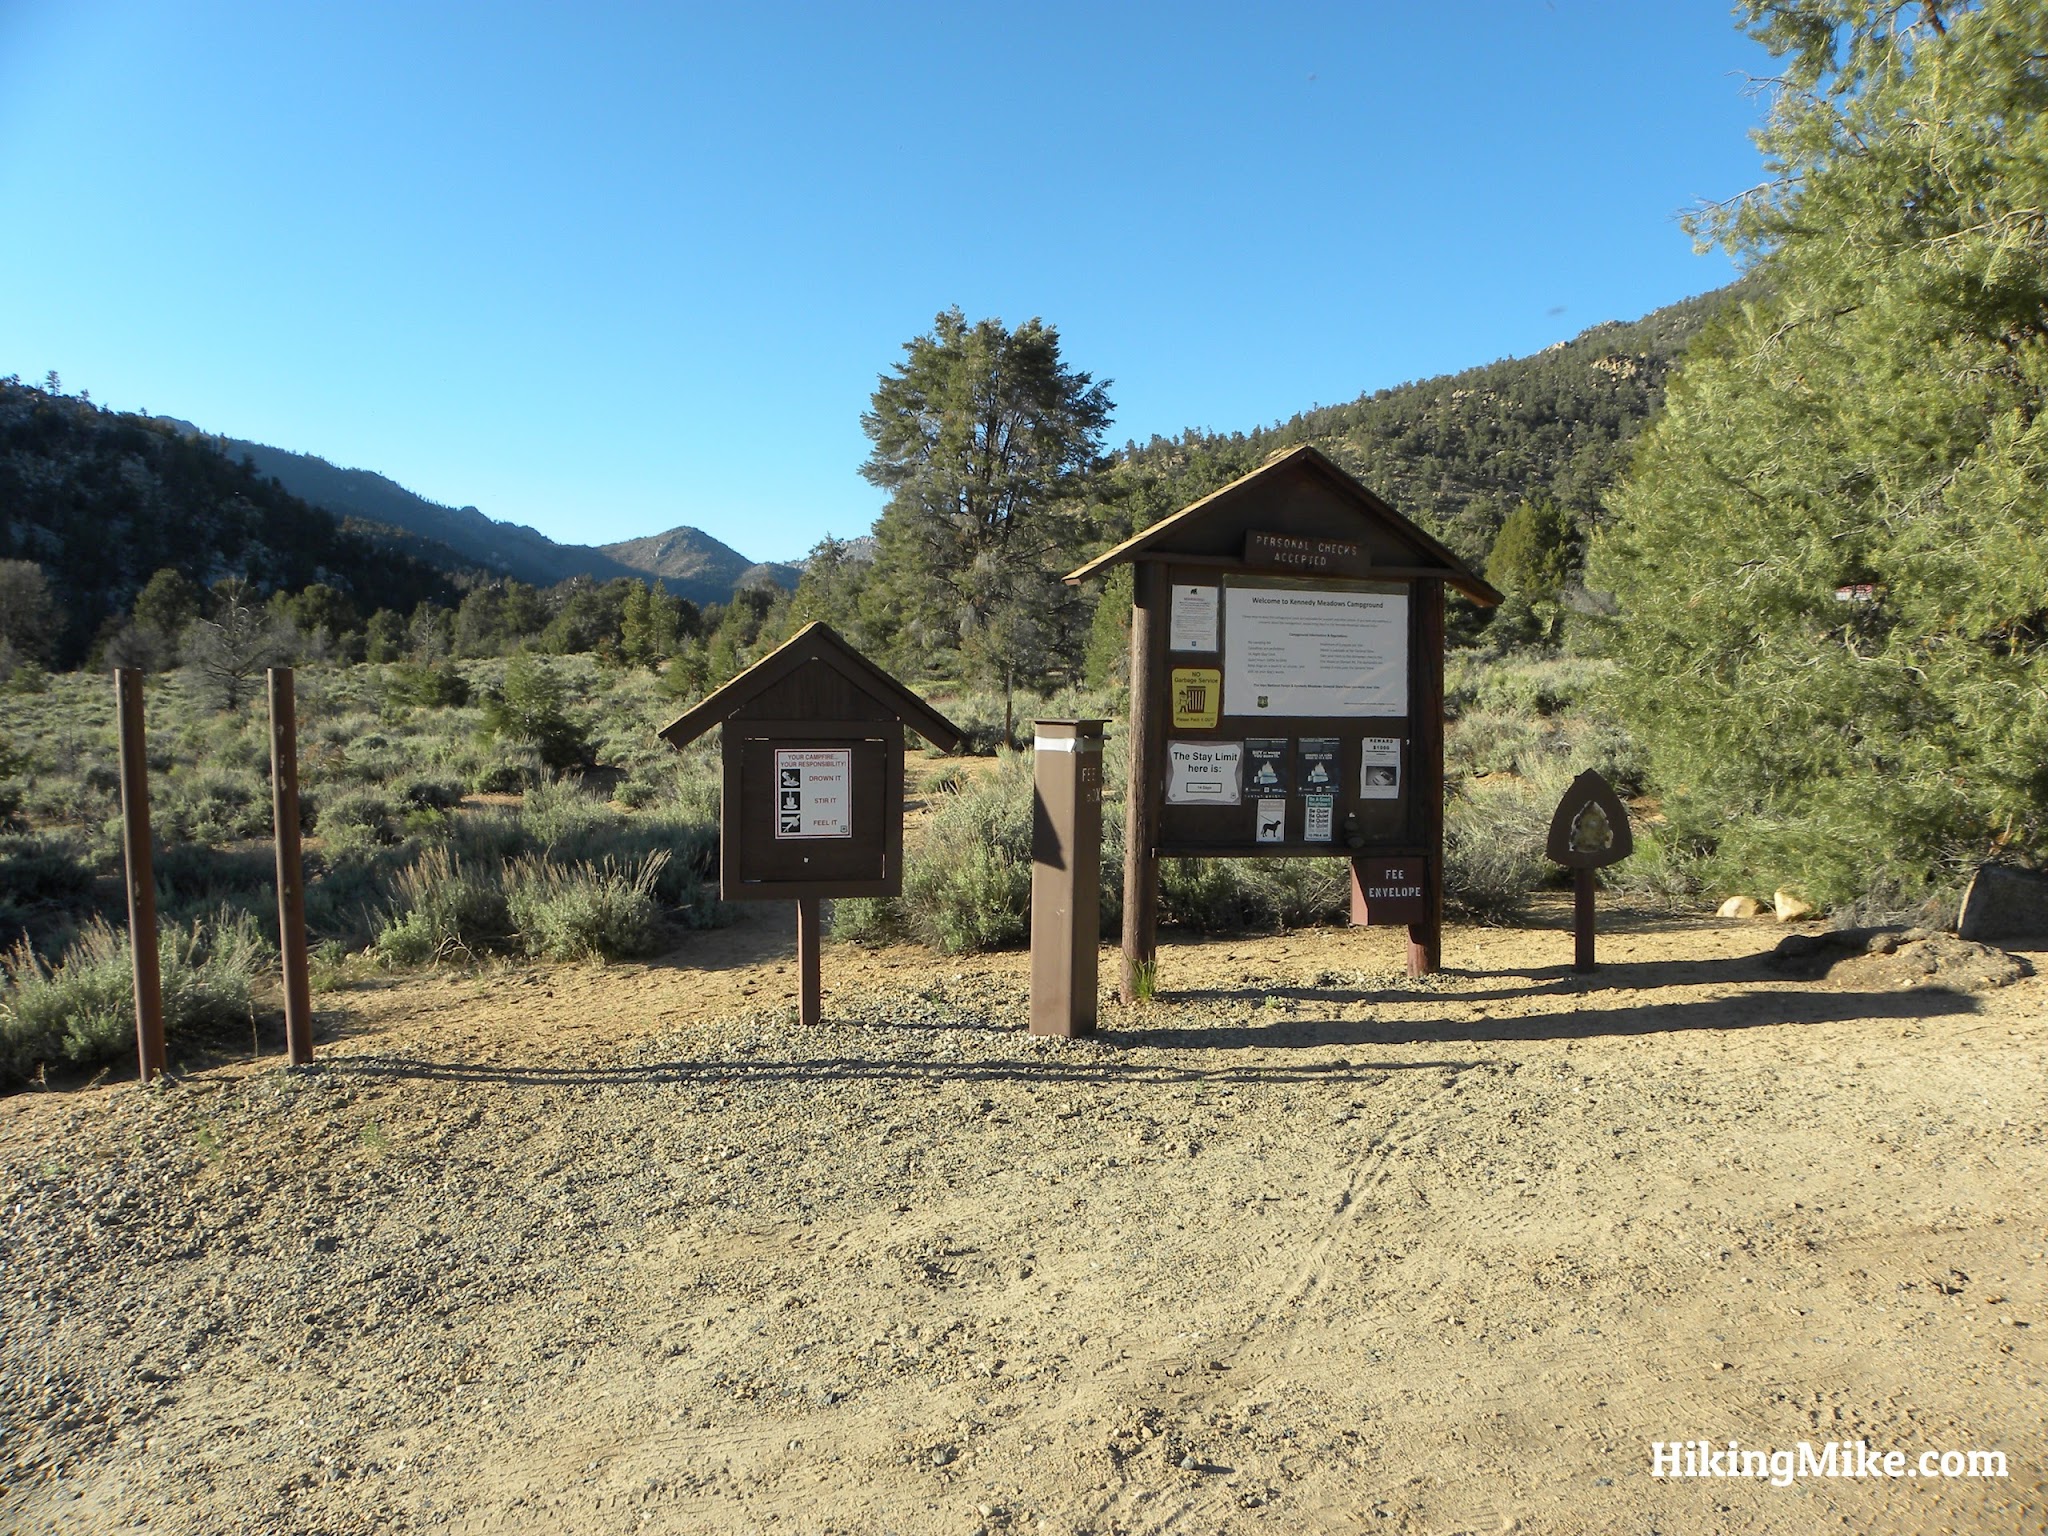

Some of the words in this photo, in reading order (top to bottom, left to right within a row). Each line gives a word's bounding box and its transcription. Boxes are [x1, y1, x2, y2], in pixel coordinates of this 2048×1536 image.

[1256, 536, 1309, 550] PERSONAL
[1318, 543, 1357, 556] CHECKS
[1274, 552, 1327, 566] ACCEPTED
[1347, 601, 1383, 609] Campground
[1174, 752, 1190, 760] The
[1192, 752, 1212, 762] Stay
[1216, 753, 1237, 761] Limit
[1188, 764, 1208, 772] here
[1082, 768, 1096, 782] FEE
[1385, 870, 1404, 880] FEE
[1368, 887, 1421, 898] ENVELOPE
